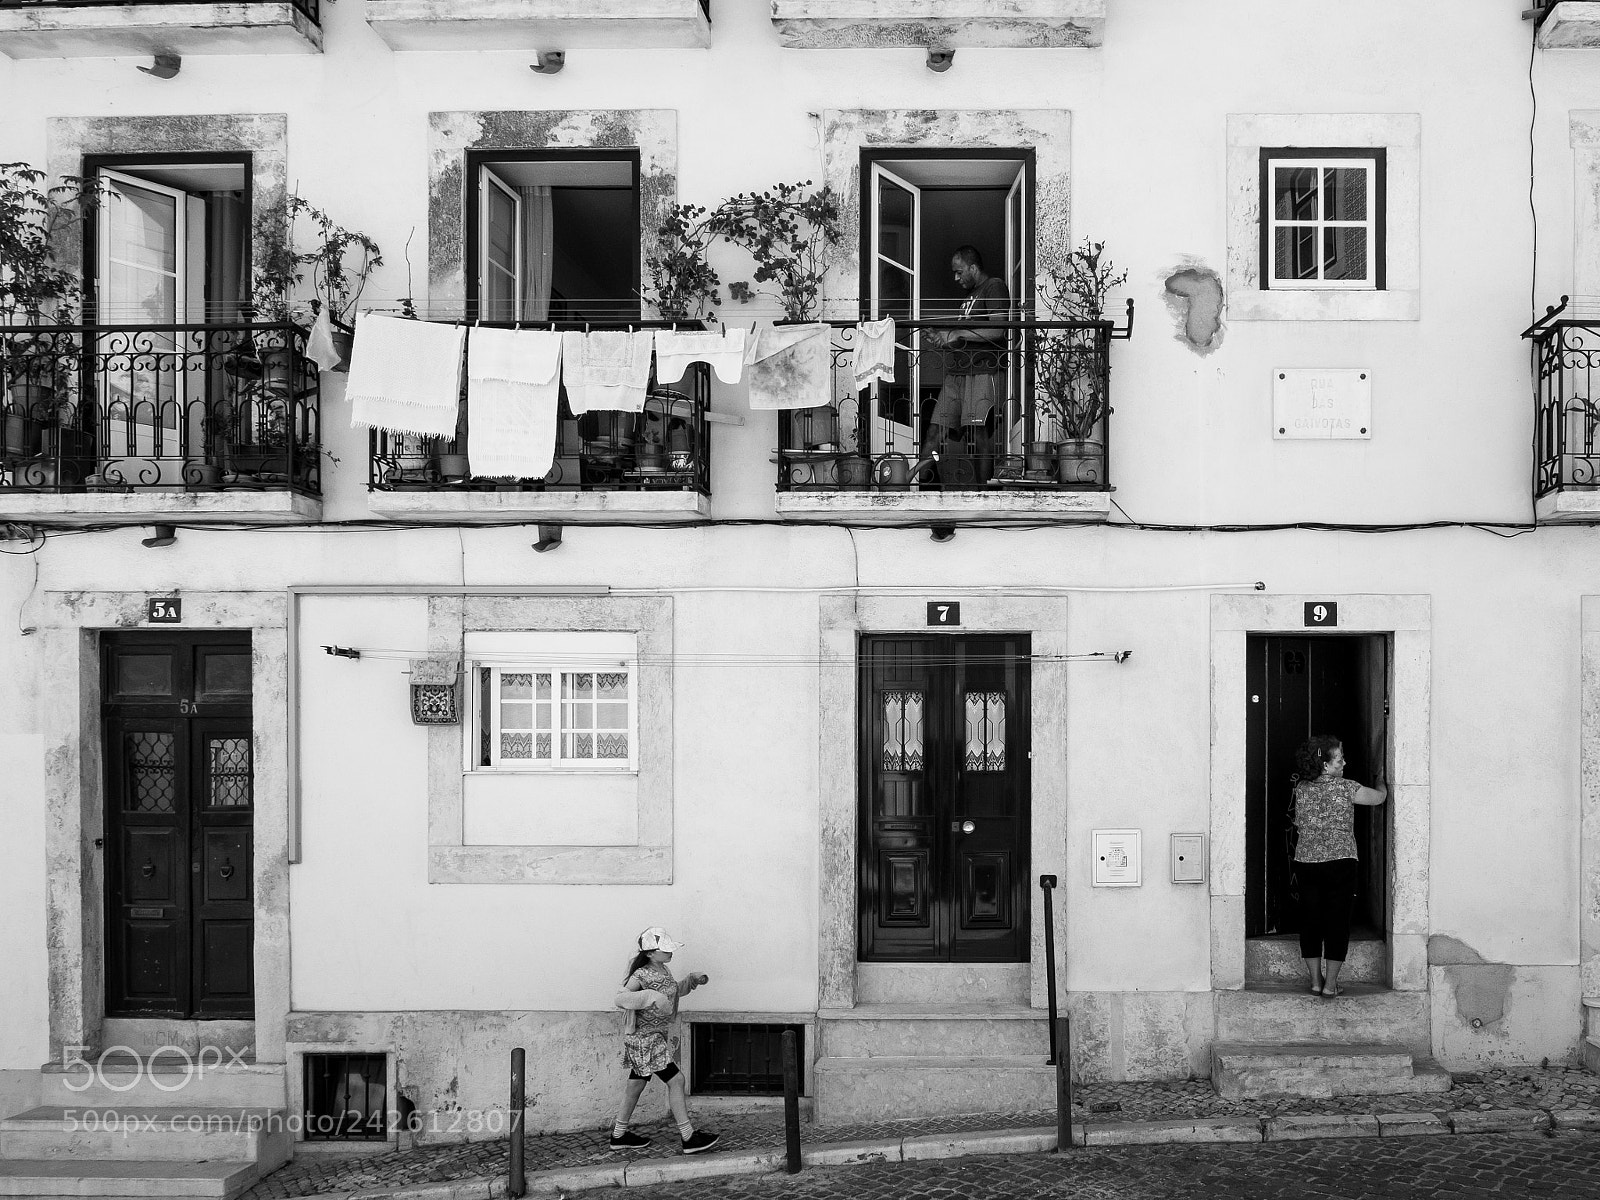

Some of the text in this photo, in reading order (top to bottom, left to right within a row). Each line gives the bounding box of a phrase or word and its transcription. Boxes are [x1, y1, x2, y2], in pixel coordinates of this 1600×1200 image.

[1310, 378, 1334, 389] RUA
[1312, 398, 1334, 409] DAS
[152, 601, 177, 618] 5A
[937, 605, 950, 622] 7
[1313, 604, 1328, 622] 9
[180, 698, 198, 714] 5A
